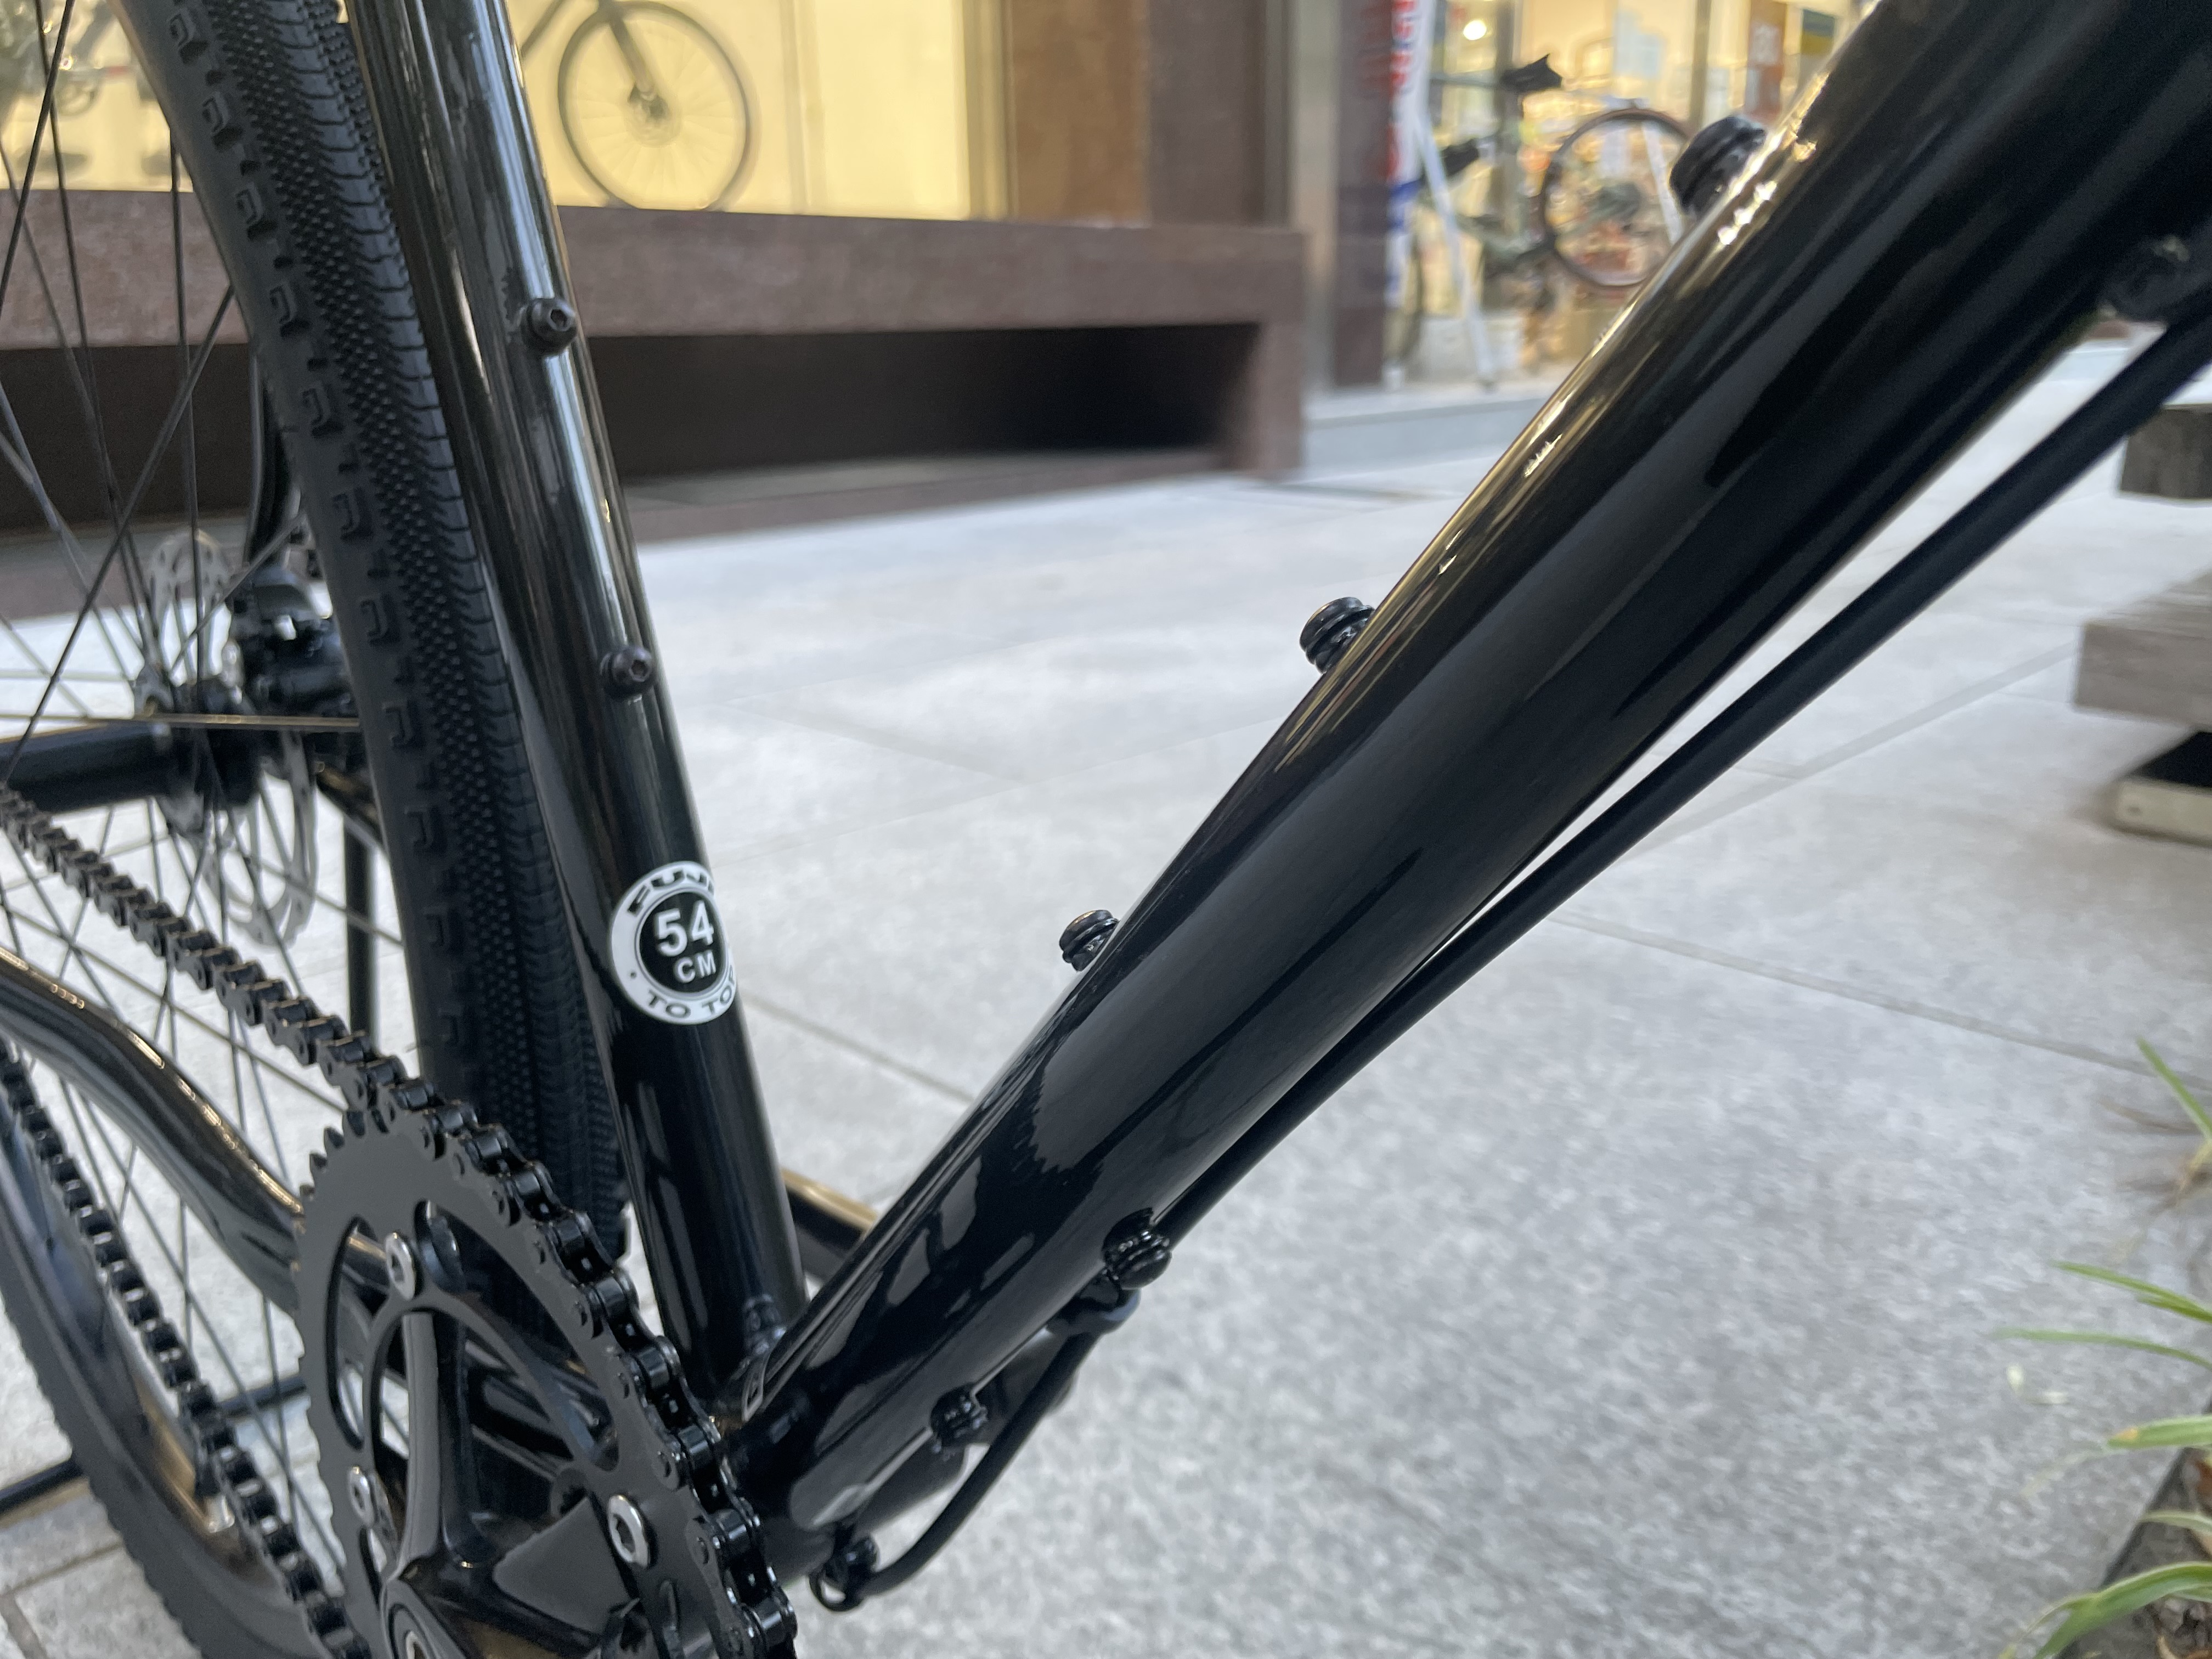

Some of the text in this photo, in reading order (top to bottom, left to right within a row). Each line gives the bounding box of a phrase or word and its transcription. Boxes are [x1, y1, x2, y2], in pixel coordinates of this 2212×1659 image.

[656, 900, 714, 957] 54
[674, 949, 716, 983] CM
[648, 989, 691, 1018] TO
